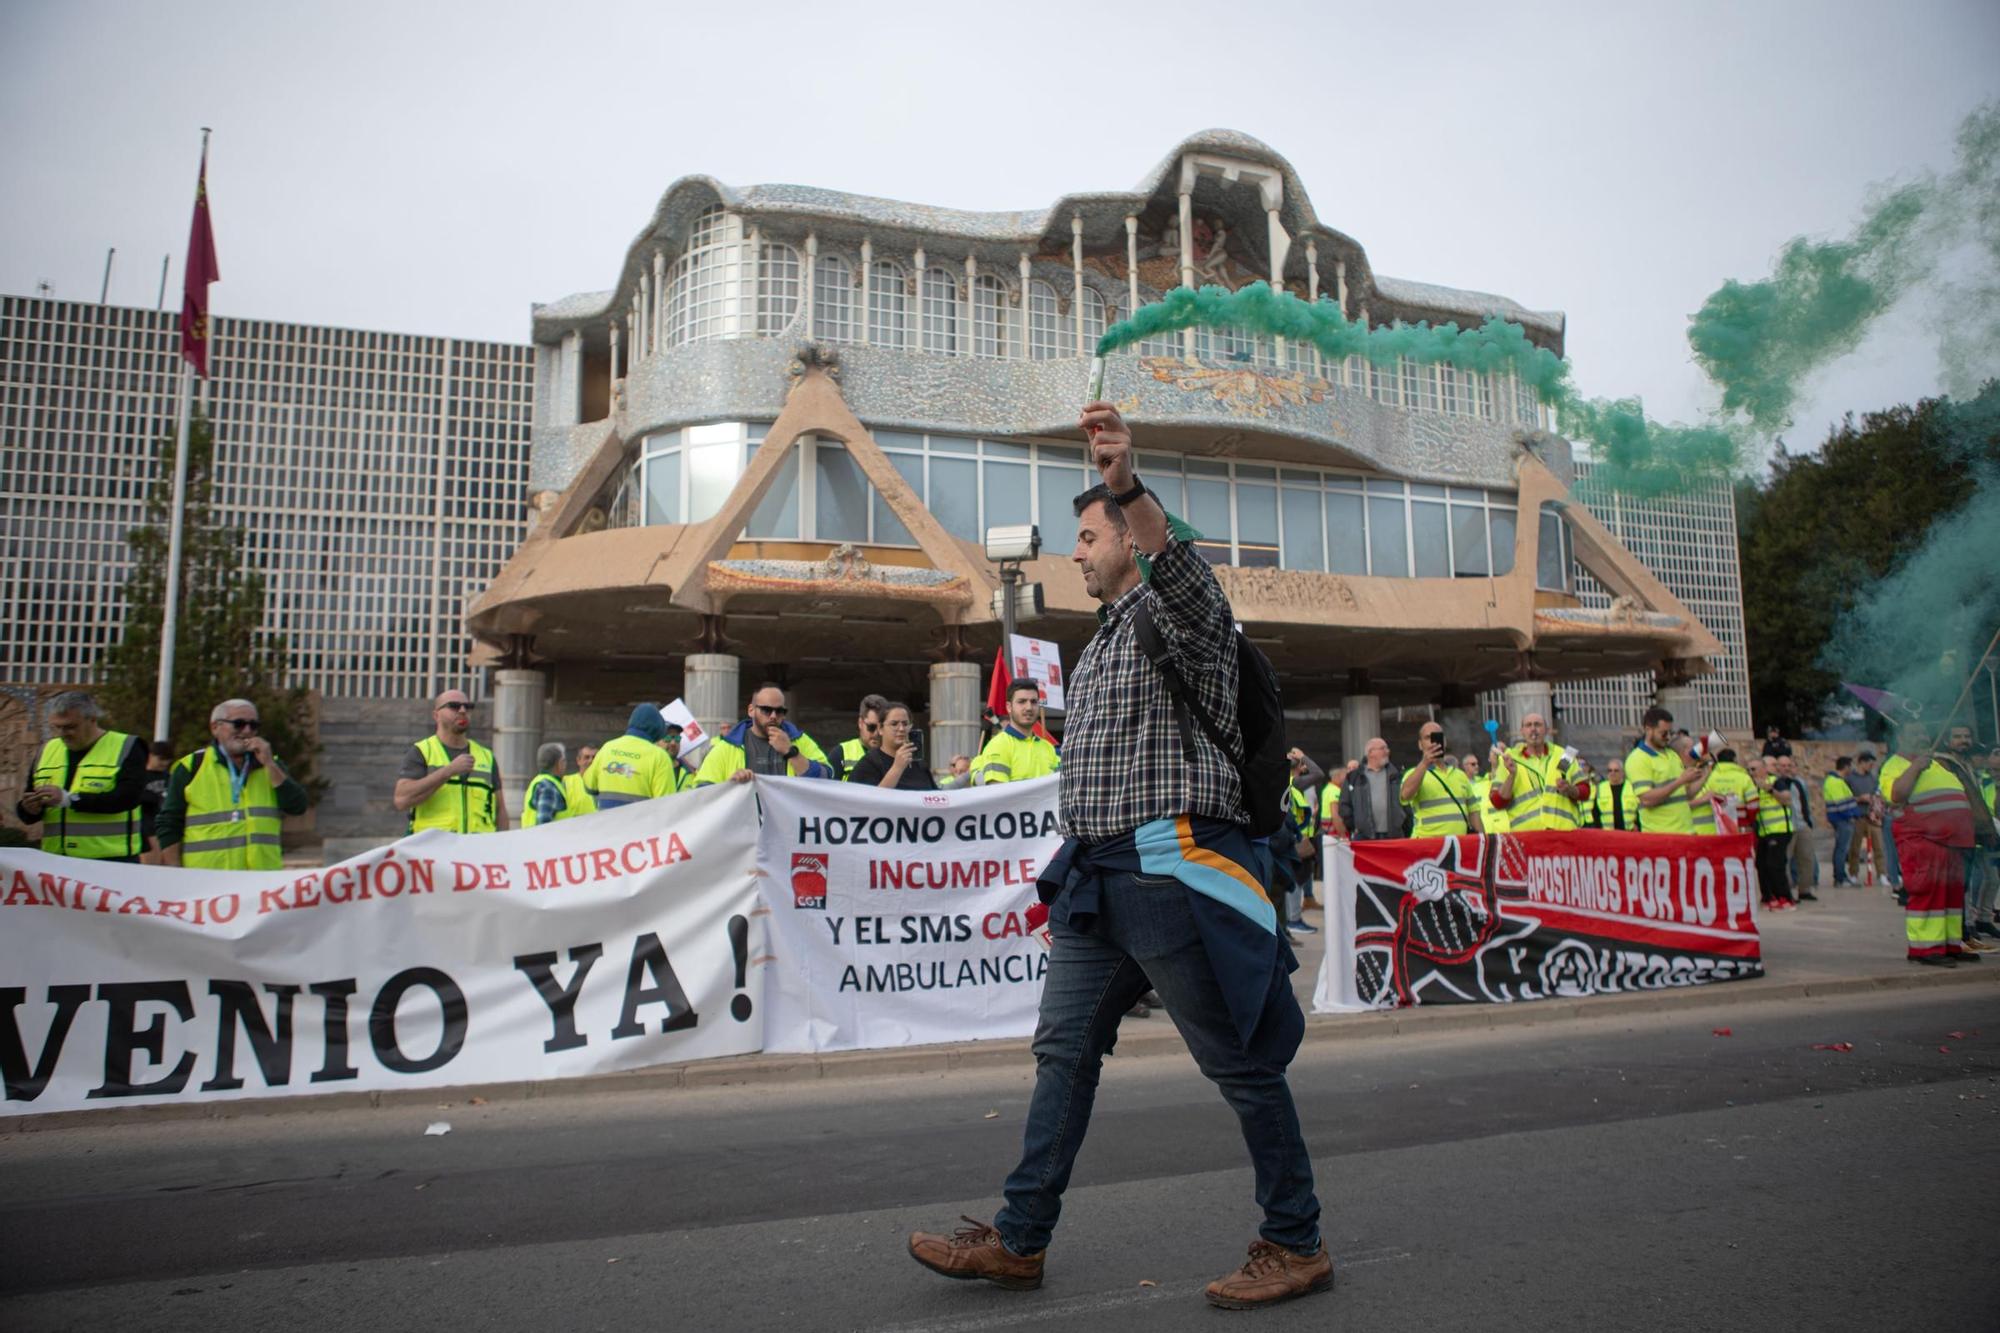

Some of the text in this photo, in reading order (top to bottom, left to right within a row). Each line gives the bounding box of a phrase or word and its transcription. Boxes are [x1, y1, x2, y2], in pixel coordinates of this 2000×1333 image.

[799, 815, 946, 845] HOZONO
[0, 832, 692, 925] ANITARIO REGIÓN DE MURCIA
[870, 858, 1037, 890] INCUMPLE
[797, 896, 824, 908] CGT
[1527, 855, 1622, 912] APOSTAMOS
[1624, 856, 1675, 921] POR
[1679, 856, 1718, 927] LO
[826, 917, 844, 945] Y
[856, 917, 891, 944] EL
[900, 914, 972, 944] SMS
[0, 965, 469, 1102] VENIO
